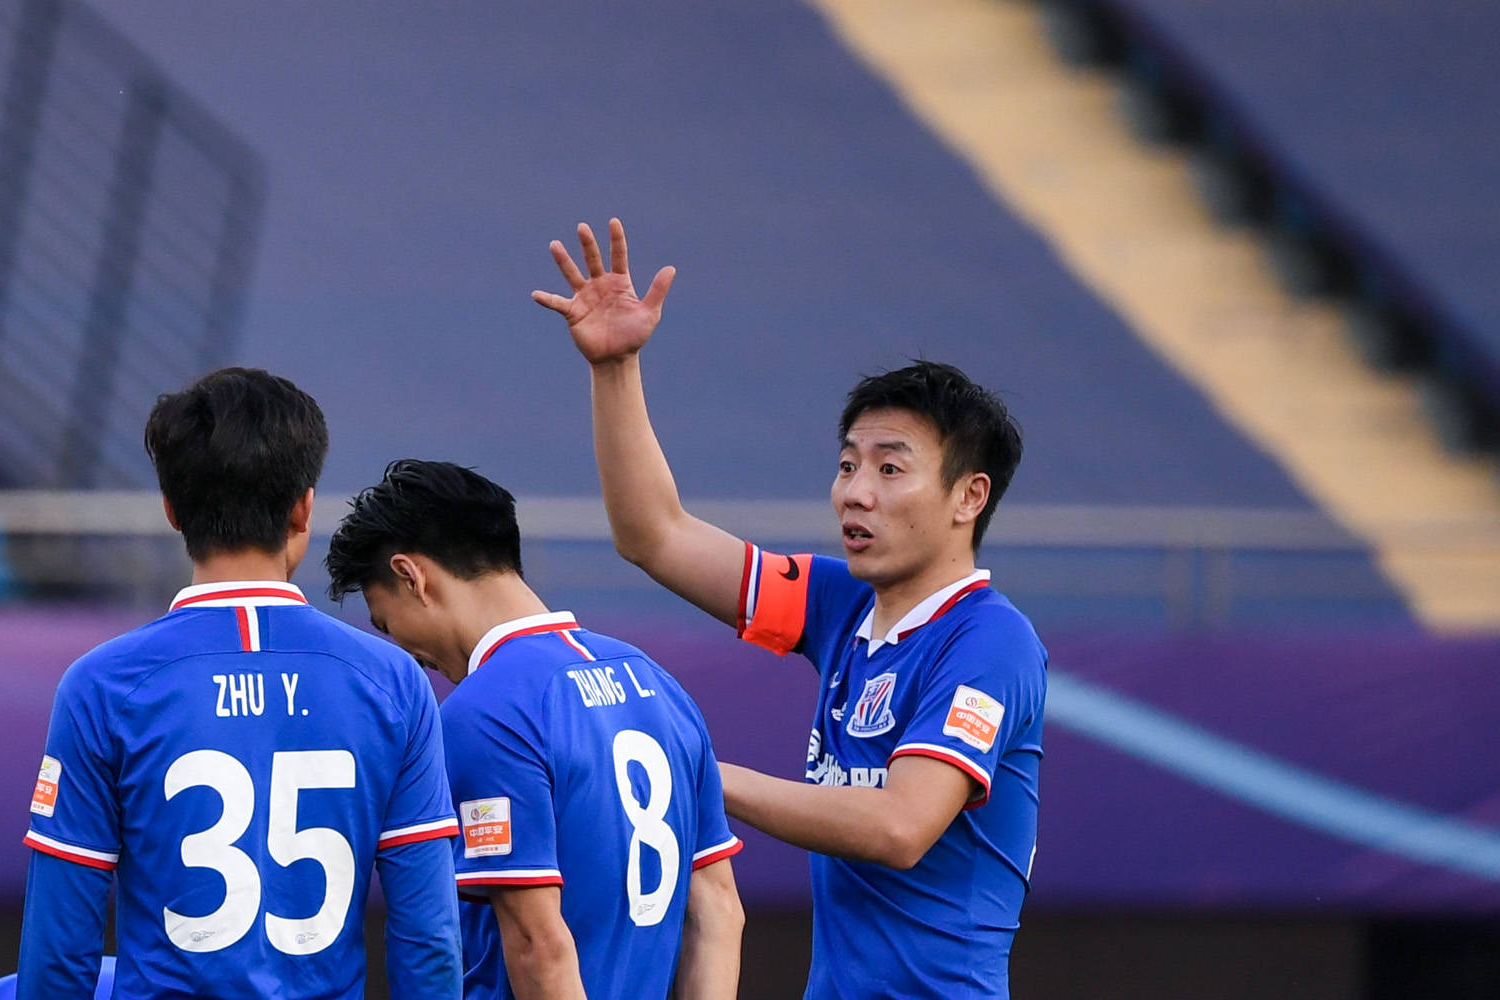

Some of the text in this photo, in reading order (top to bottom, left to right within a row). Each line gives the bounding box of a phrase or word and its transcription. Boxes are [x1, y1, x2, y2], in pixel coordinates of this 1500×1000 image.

[213, 673, 309, 717] ZHU Y.
[566, 661, 656, 708] ZHANG L.
[164, 749, 356, 956] 35
[613, 729, 680, 926] 8
